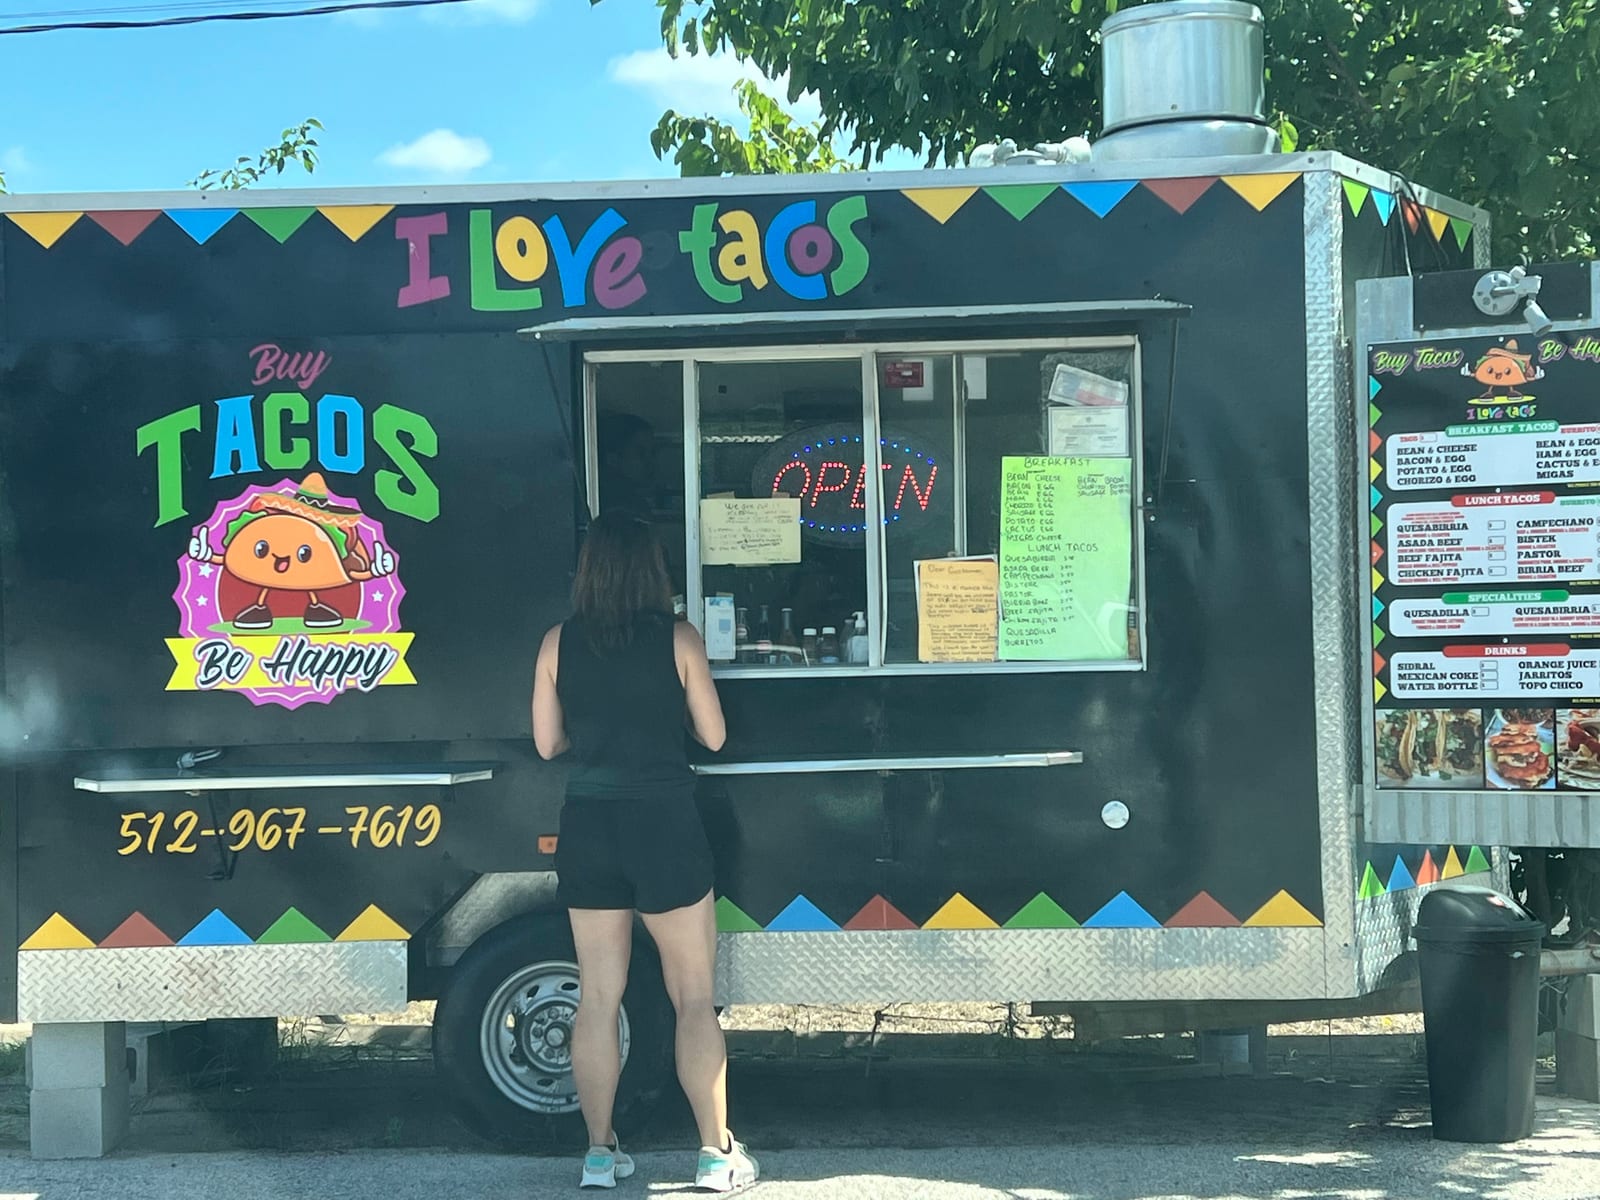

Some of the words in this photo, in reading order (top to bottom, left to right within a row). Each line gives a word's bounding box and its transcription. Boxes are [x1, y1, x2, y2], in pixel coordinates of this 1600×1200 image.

[395, 212, 450, 308] I
[1539, 339, 1566, 362] Be
[249, 343, 332, 389] Buy
[1373, 350, 1411, 375] Buy
[1415, 347, 1463, 371] Tacos
[1466, 409, 1475, 420] I
[1448, 424, 1514, 437] BREAKFAST
[1518, 422, 1555, 433] TACOS
[1536, 440, 1566, 448] BEAN
[1397, 447, 1425, 455] BEAN
[1437, 444, 1477, 453] CHEESE
[1536, 450, 1562, 458] HAM
[1575, 449, 1597, 457] EGG
[136, 392, 440, 528] TACOS
[1024, 457, 1090, 468] BREAKFAST
[1397, 457, 1432, 465] BACON
[1445, 455, 1466, 463] EGG
[1536, 460, 1580, 469] CACTUS
[1583, 459, 1589, 467] &
[1397, 466, 1439, 476] POTATO
[1450, 465, 1472, 473] EGG
[1537, 470, 1574, 479] MIGAS
[1397, 476, 1443, 485] CHORIZO
[1455, 475, 1476, 483] EGG
[1465, 496, 1501, 505] LUNCH
[1503, 494, 1540, 504] TACOS
[1397, 523, 1468, 533] QUESABIRRIA
[1516, 518, 1594, 528] CAMPECHANO
[1437, 538, 1463, 546] BEEF
[1517, 535, 1556, 543] BISTEK
[1028, 543, 1060, 552] LUNCH
[1066, 543, 1099, 552] TACOS
[1397, 554, 1422, 562] BEEF
[1425, 553, 1462, 563] FAJITA
[1517, 550, 1561, 559] PASTOR
[1398, 569, 1444, 577] CHICKEN
[1446, 568, 1484, 578] FAJITA
[1517, 566, 1555, 574] BIRRIA
[1558, 565, 1584, 573] BEEF
[1468, 592, 1542, 602] SPECIALITIES
[1404, 609, 1470, 618] QUESADILLA
[1515, 606, 1590, 615] QUESABIRRIA
[1484, 647, 1527, 656] DRINKS
[198, 641, 248, 687] Be
[264, 637, 396, 692] Happy
[1518, 661, 1565, 669] ORANGE
[1567, 660, 1597, 670] JUICE
[1398, 672, 1447, 680] MEXICAN
[1449, 672, 1479, 680] COKE
[1519, 671, 1572, 680] JARRITOS
[1398, 683, 1435, 691] WATER
[1438, 682, 1478, 690] BOTTLE
[1519, 682, 1547, 690] TOPO
[1549, 682, 1583, 690] CHICO
